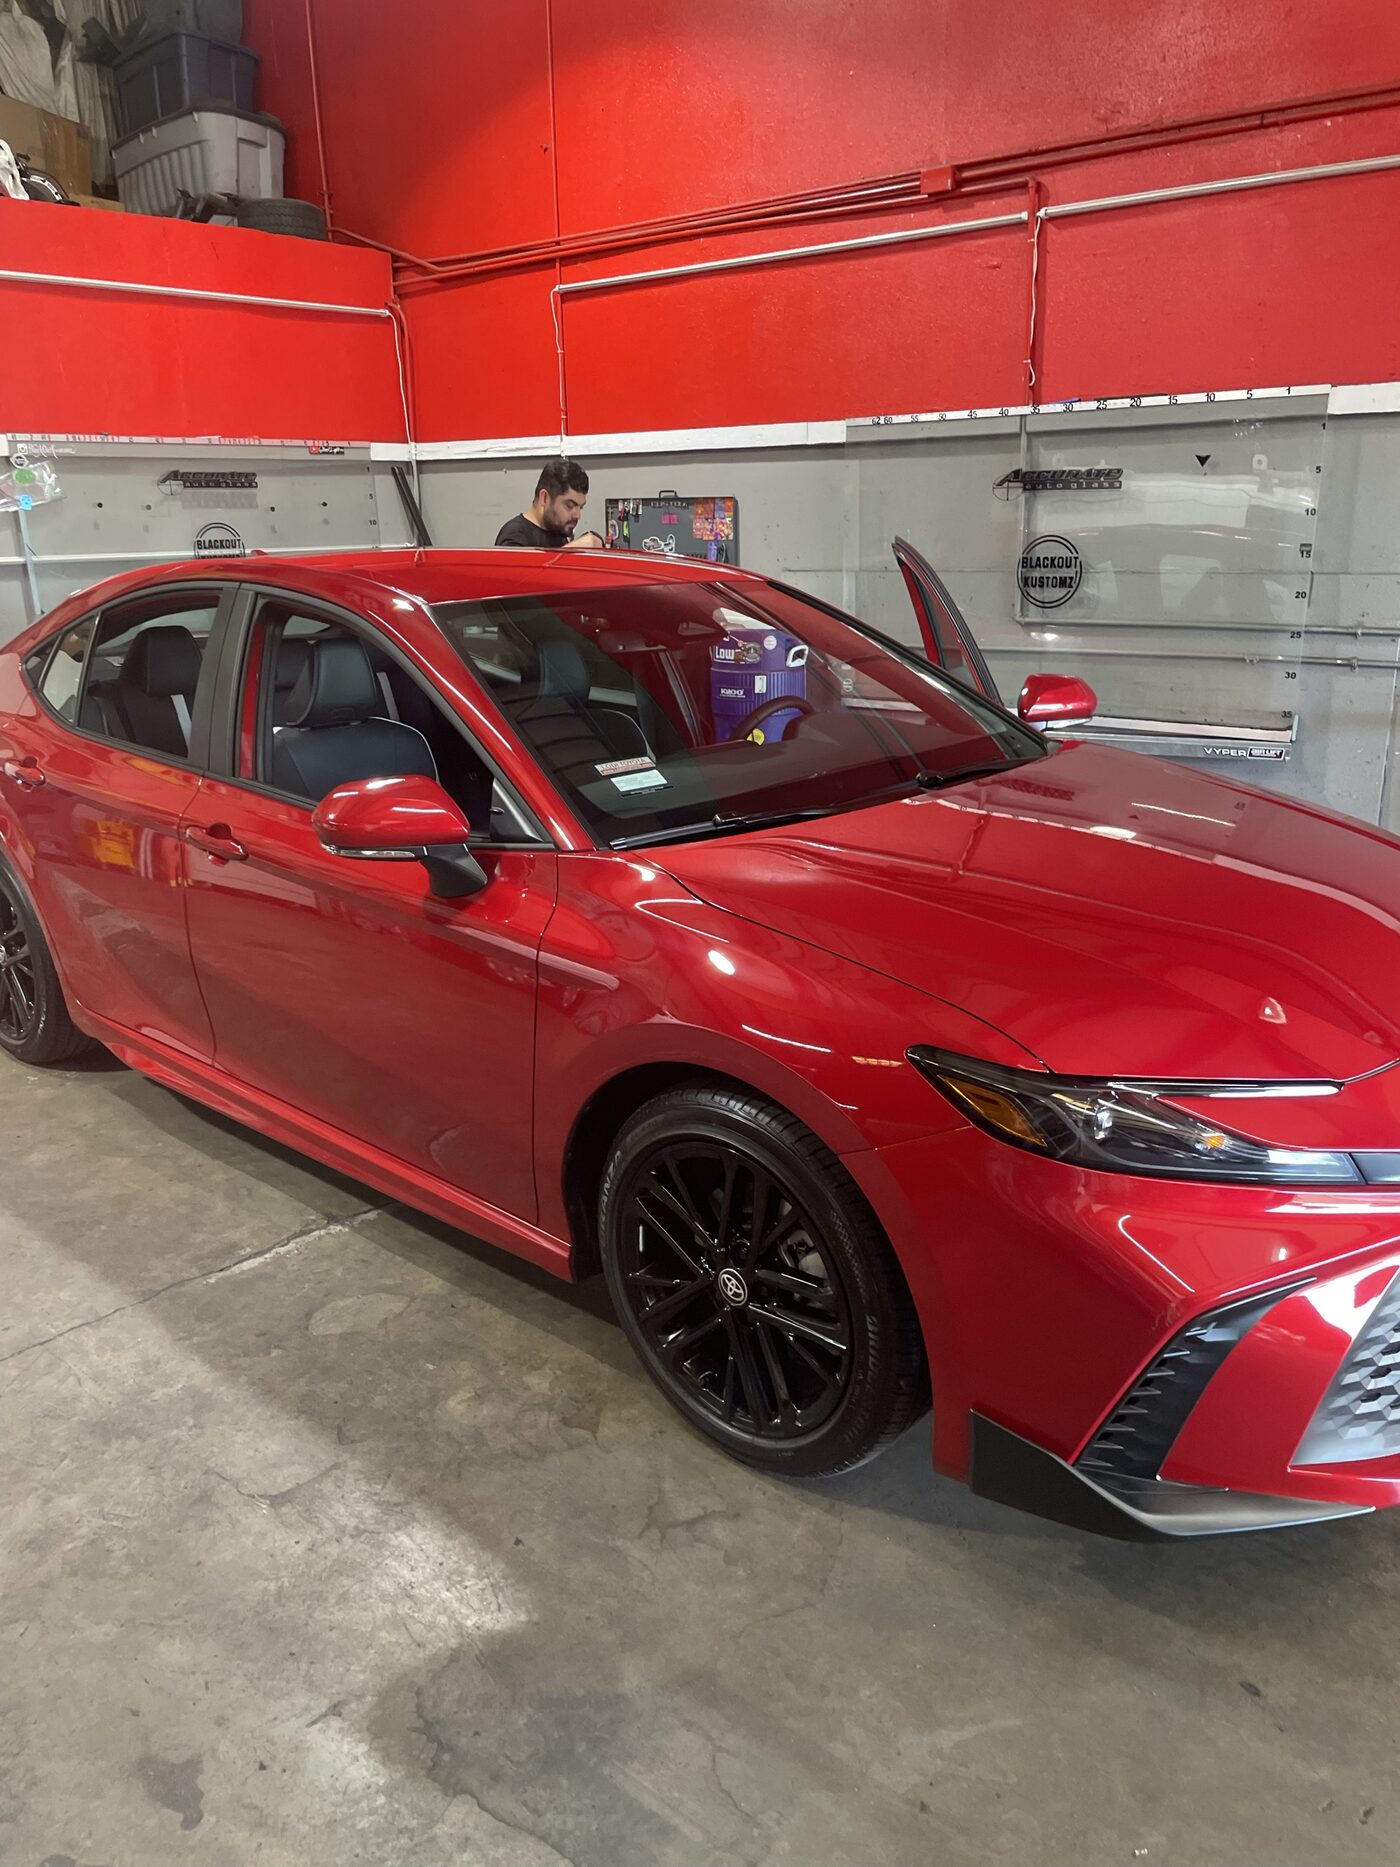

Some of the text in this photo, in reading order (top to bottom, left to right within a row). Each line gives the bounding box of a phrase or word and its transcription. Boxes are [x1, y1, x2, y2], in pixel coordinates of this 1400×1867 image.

[872, 416, 881, 425] 62
[884, 416, 893, 424] 60
[910, 414, 919, 423] 55
[938, 412, 947, 421] 50
[967, 410, 978, 419] 45
[998, 408, 1009, 417] 40
[1030, 404, 1041, 415] 35
[1062, 402, 1074, 413] 30
[1096, 400, 1108, 410] 25
[1130, 397, 1142, 407] 20
[1168, 395, 1178, 405] 15
[1205, 391, 1216, 403] 10
[1246, 389, 1253, 400] 5
[1315, 465, 1322, 474] 5
[1070, 480, 1121, 489] glass
[1304, 507, 1317, 516] 10
[196, 539, 241, 549] BLACKOUT
[1300, 550, 1311, 559] 15
[1021, 556, 1079, 569] BLACKOUT
[1023, 576, 1075, 589] KUSTOMZ
[1295, 591, 1307, 599] 20
[1290, 631, 1302, 639] 25
[1285, 671, 1297, 680] 30
[1281, 710, 1293, 719] 35
[1203, 746, 1247, 757] VYPER
